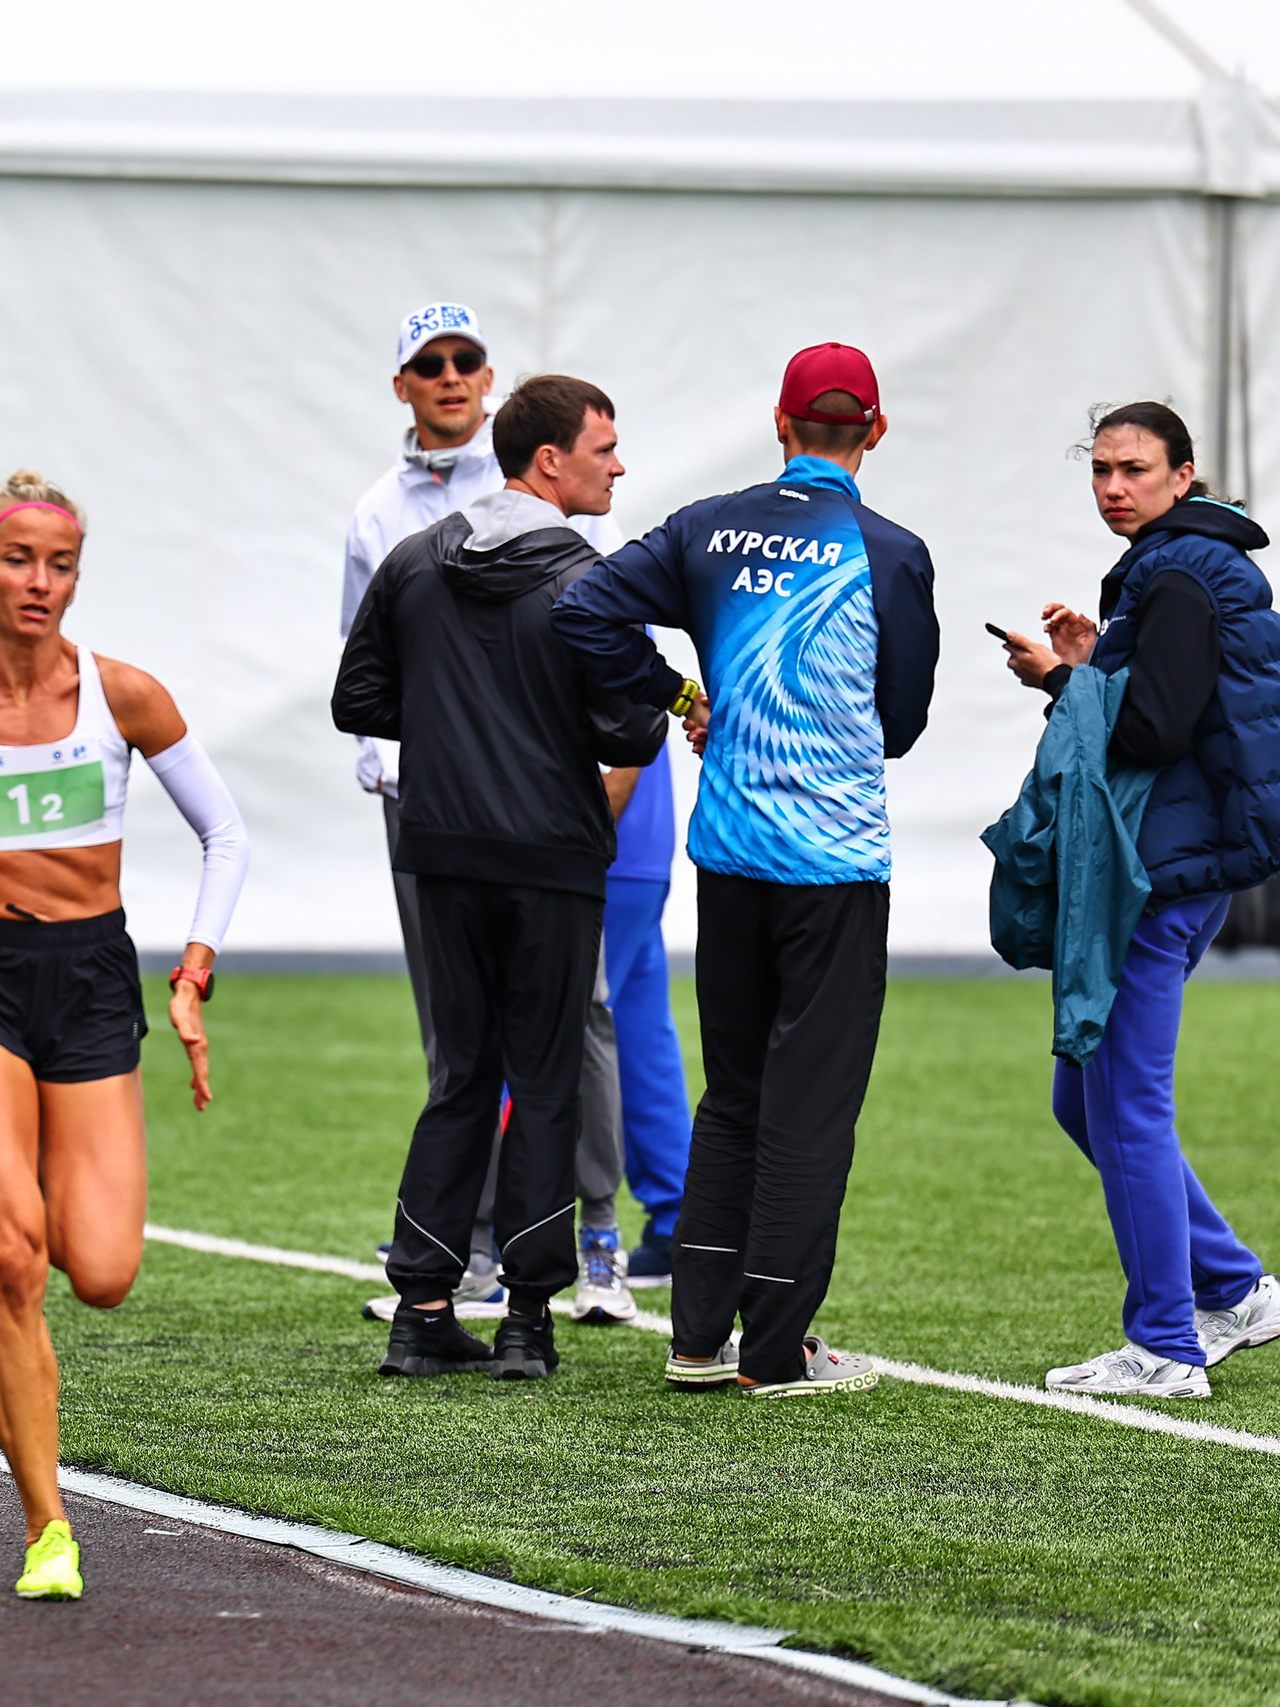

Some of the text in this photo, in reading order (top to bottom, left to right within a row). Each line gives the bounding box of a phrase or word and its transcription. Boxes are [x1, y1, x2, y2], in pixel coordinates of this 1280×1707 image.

[706, 529, 843, 567] КУРСКАЯ
[731, 566, 795, 597] АЭС
[835, 1372, 877, 1391] crocs
